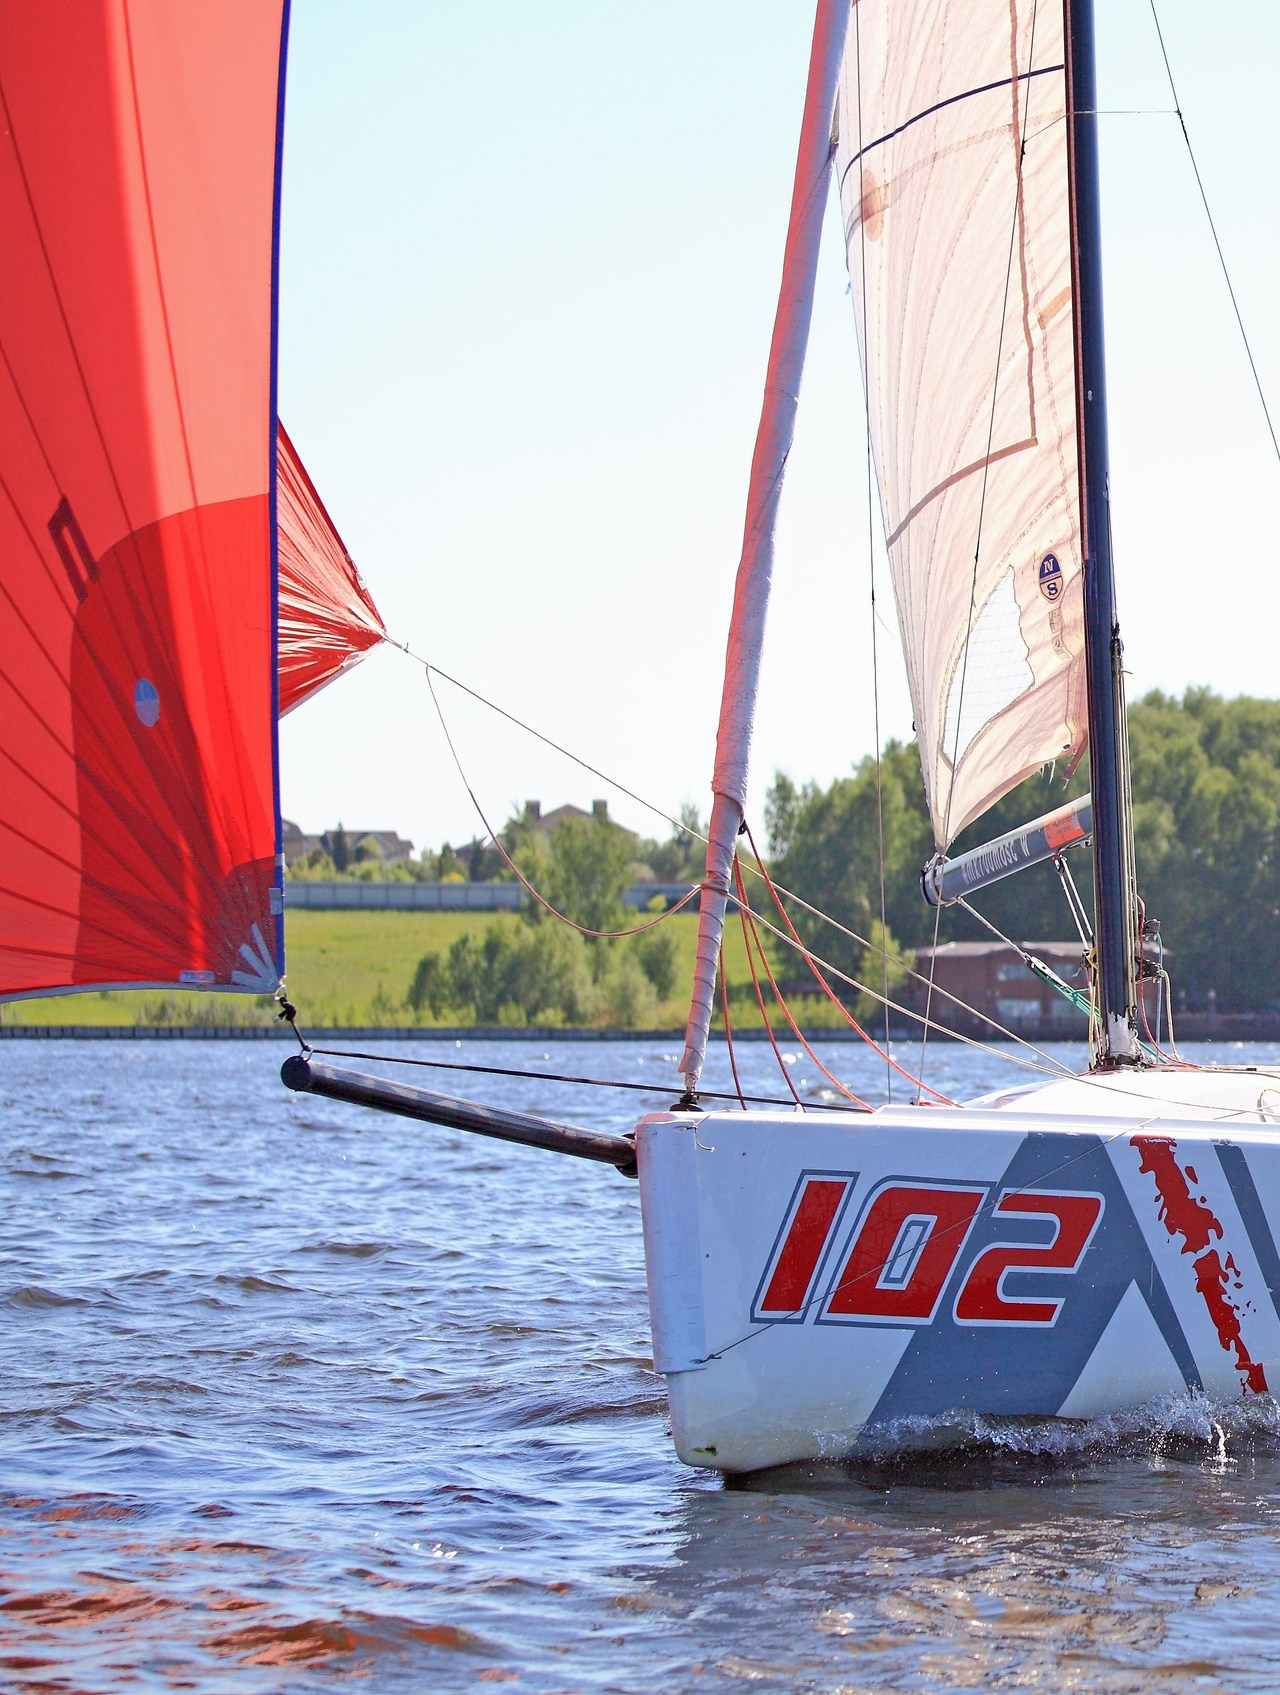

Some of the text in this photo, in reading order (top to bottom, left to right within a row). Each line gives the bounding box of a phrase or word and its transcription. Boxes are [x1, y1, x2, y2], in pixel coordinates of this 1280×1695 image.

[1043, 558, 1054, 573] N
[1047, 582, 1058, 596] S
[754, 1173, 1103, 1326] 102
